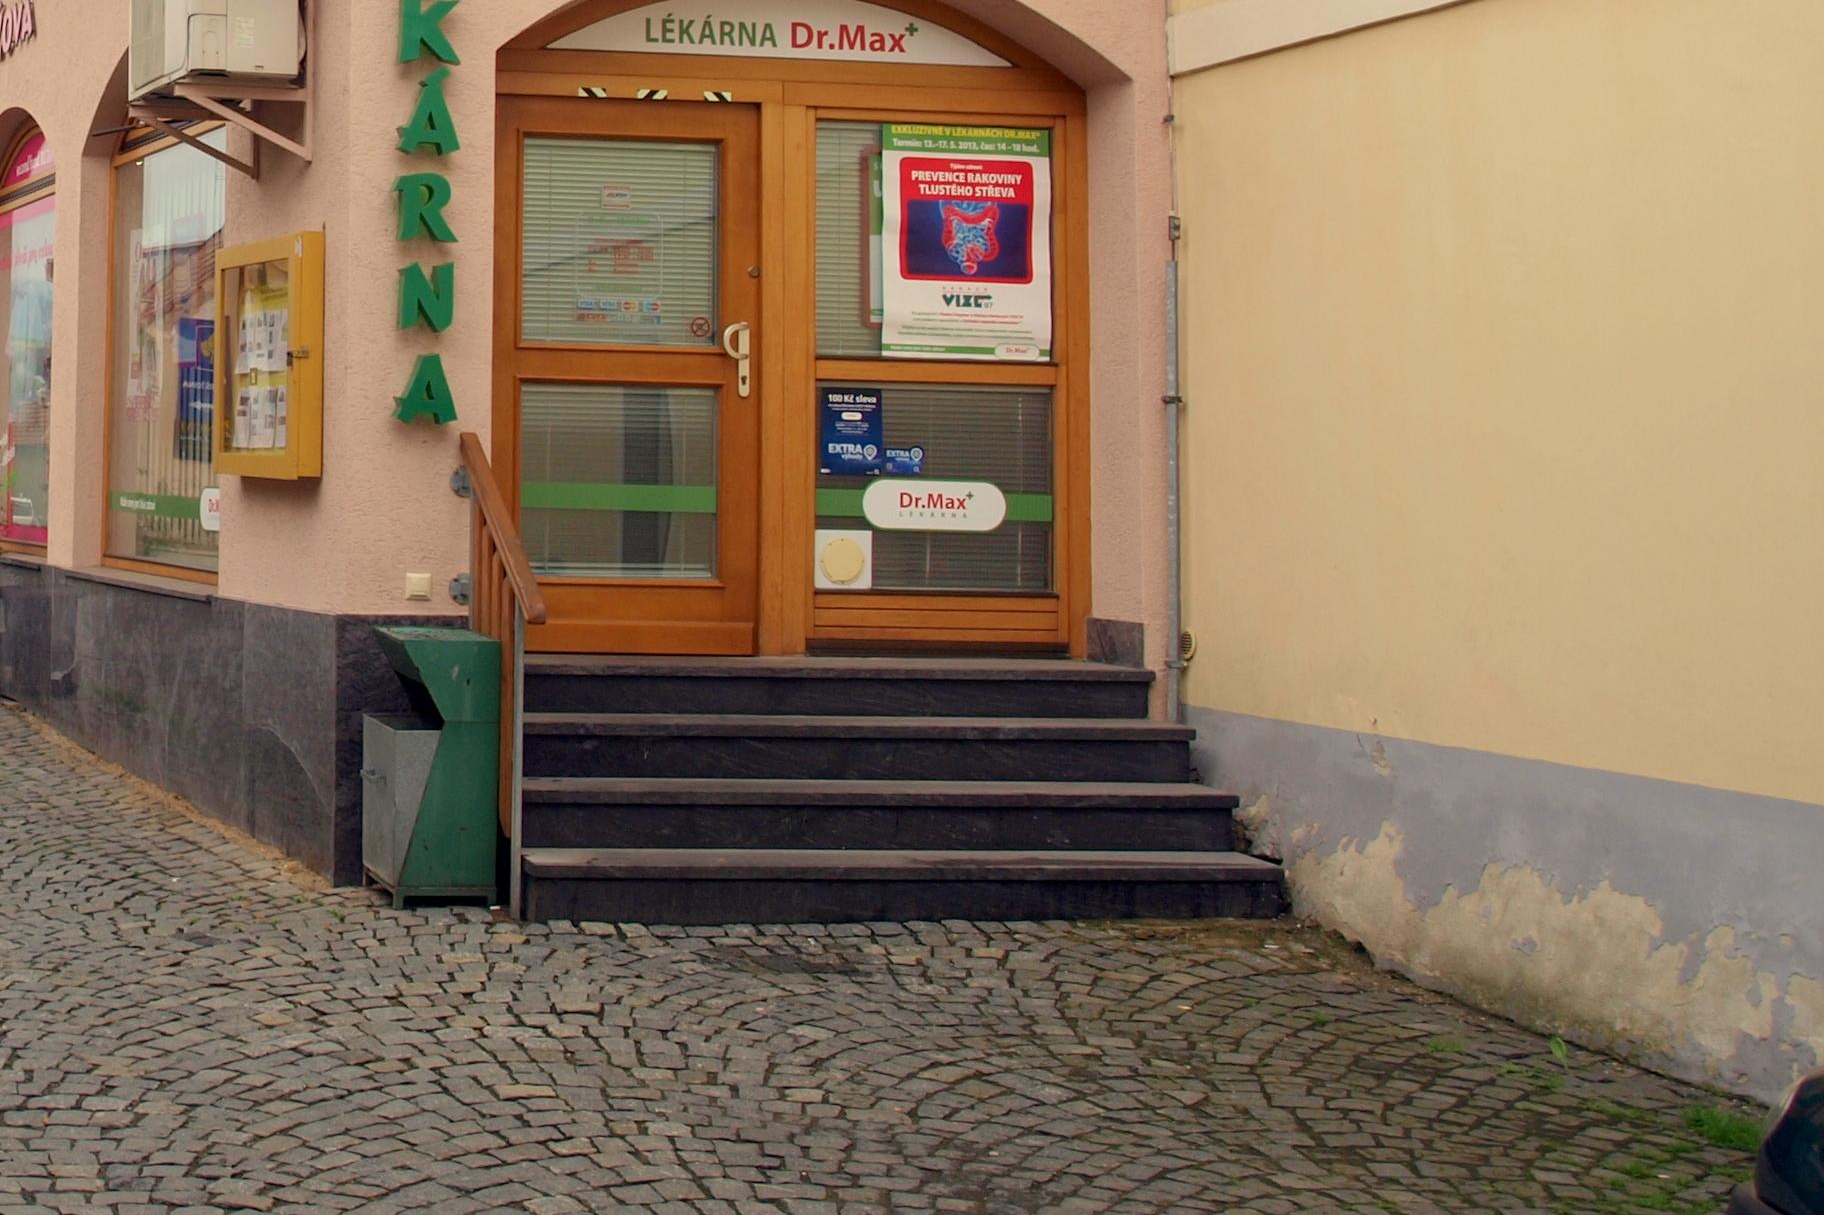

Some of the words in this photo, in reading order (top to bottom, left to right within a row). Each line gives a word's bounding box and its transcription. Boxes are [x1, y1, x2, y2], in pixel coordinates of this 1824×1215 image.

[644, 13, 778, 48] LÉKÁRNA
[944, 126, 951, 136] V
[911, 170, 965, 183] PREVENCE
[967, 172, 1022, 185] RAKOVINY
[918, 183, 974, 196] TLUSTÉHO
[975, 185, 1015, 198] STŘEVA
[828, 443, 863, 454] EXTRA
[886, 449, 910, 458] EXTRA
